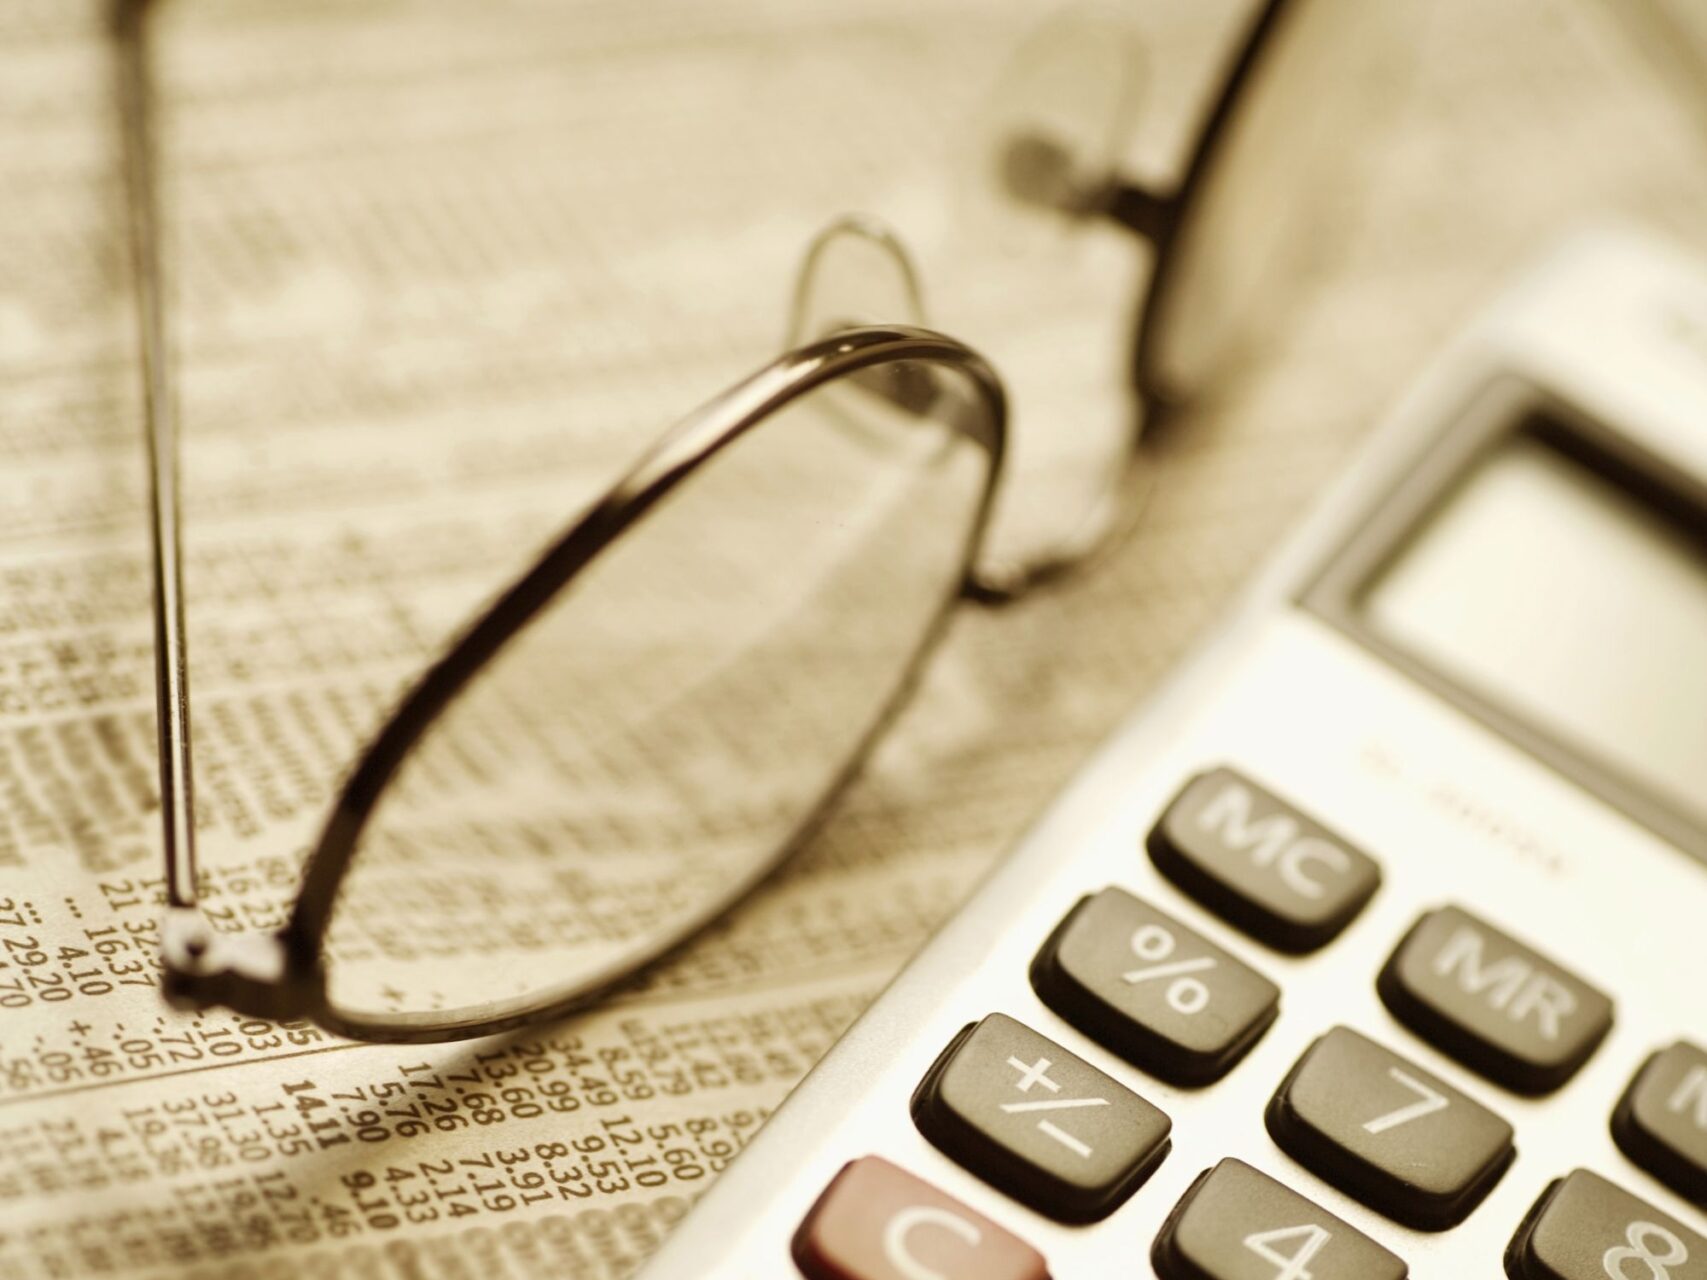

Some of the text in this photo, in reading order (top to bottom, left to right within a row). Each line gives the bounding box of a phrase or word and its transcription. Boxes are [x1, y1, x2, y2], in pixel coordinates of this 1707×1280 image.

[99, 879, 142, 912] 21
[1198, 784, 1351, 897] MC
[2, 936, 73, 1002] 29.20
[57, 946, 114, 996] 4.10
[83, 925, 156, 988] 16.37
[1122, 924, 1218, 1014] %
[1430, 927, 1577, 1040] MR
[203, 1092, 272, 1161] 31.30
[252, 1102, 314, 1157] 1.35
[281, 1080, 399, 1230] 14.11 9.10
[331, 1086, 439, 1225] 7.90 4.33
[369, 1081, 431, 1138] 5.76
[418, 1159, 479, 1218] 2.14
[398, 1061, 469, 1131] 17.26
[458, 1152, 517, 1212] 7.19
[446, 1068, 553, 1206] 7.68 3.91
[475, 1050, 593, 1201] 13.60 8.32
[511, 1040, 630, 1195] 20.99 9.53
[551, 1036, 668, 1188] 34.49 12.10
[648, 1123, 705, 1181] 5.60
[1362, 1067, 1451, 1134] 7
